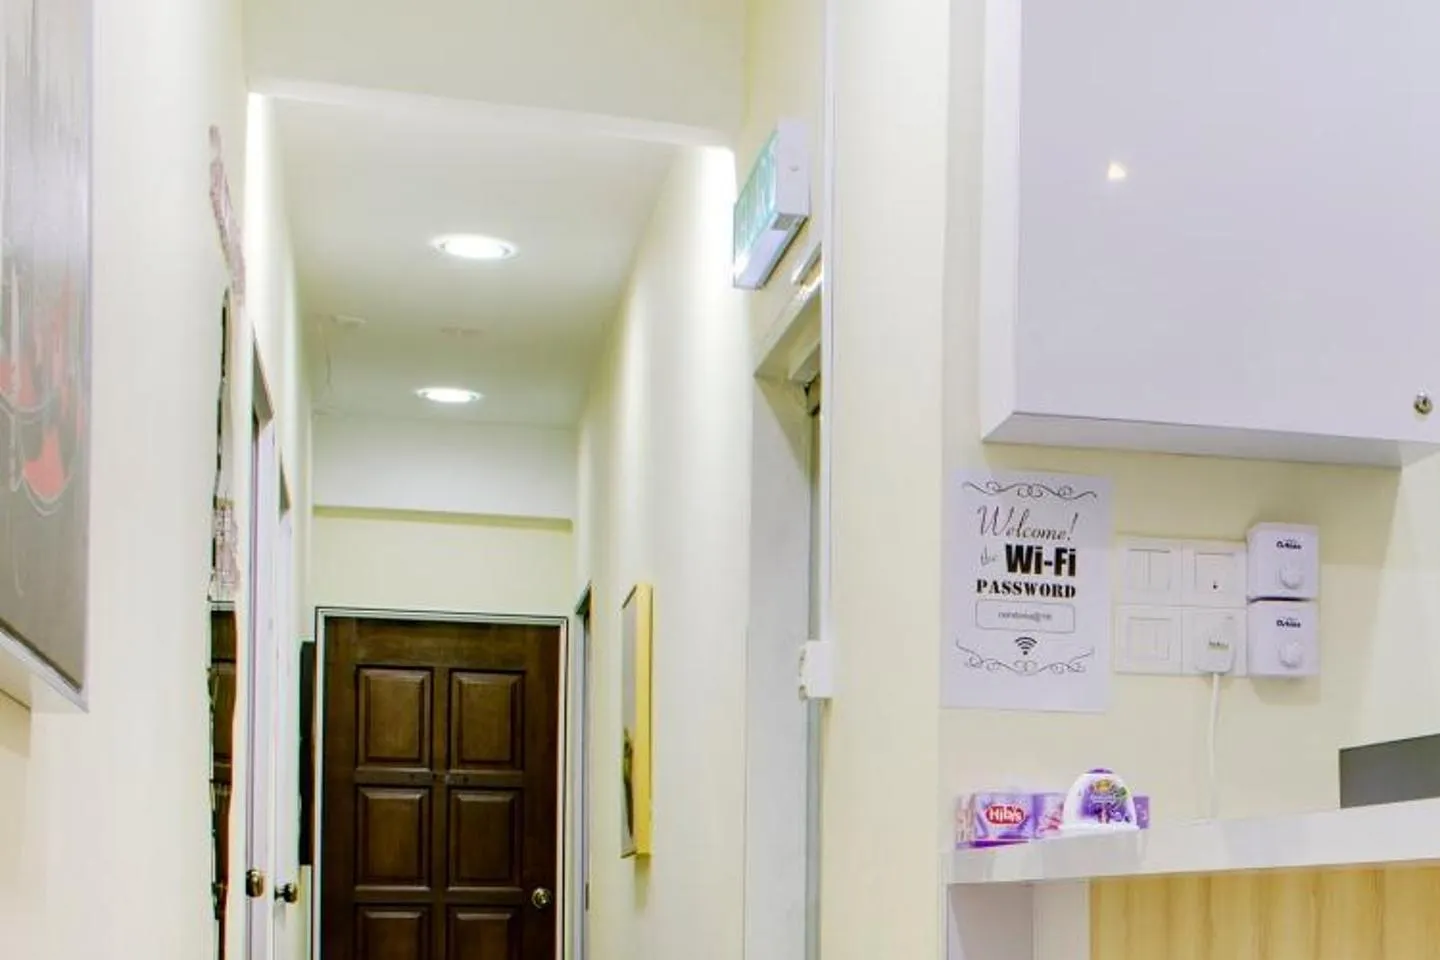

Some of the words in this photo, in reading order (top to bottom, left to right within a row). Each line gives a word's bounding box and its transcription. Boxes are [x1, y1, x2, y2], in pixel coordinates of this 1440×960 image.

[977, 505, 1079, 541] Welcome!
[1005, 543, 1077, 577] Wi-Fi
[976, 578, 1077, 599] PASSWORD
